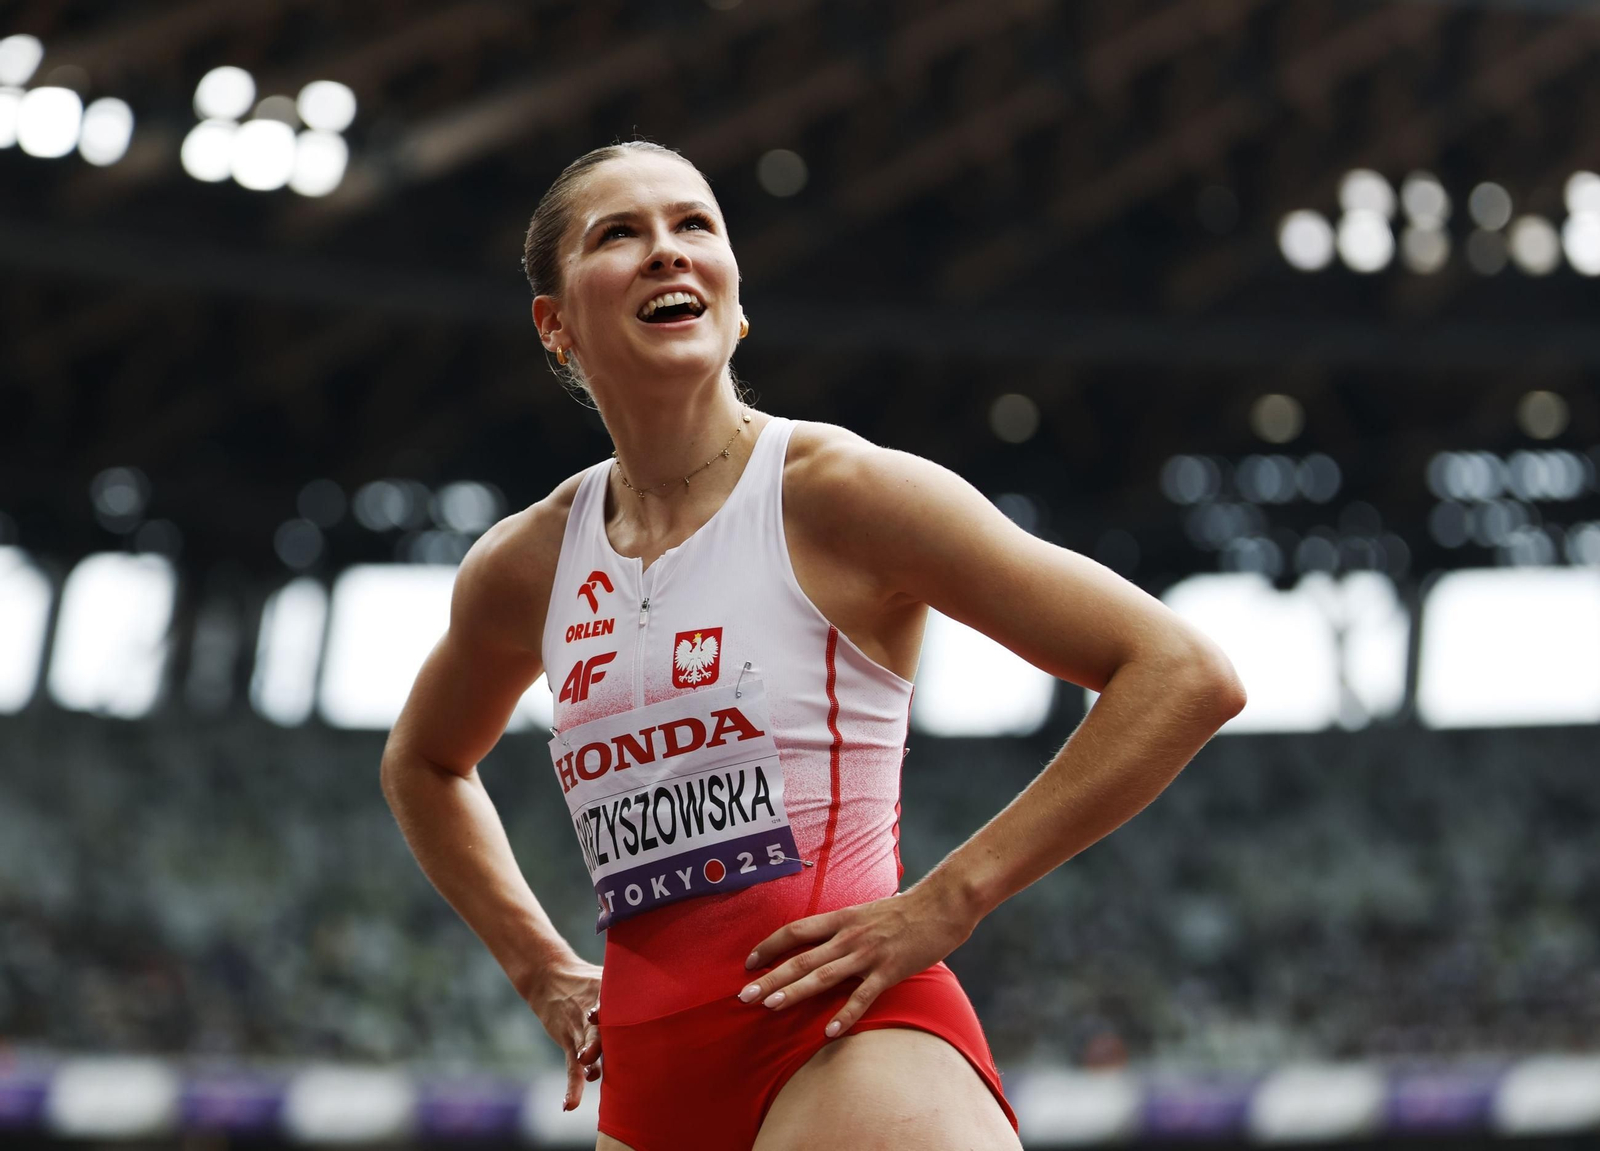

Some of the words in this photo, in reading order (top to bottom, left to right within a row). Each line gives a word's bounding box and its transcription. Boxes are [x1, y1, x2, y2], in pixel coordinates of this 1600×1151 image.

[565, 618, 615, 644] ORLEN
[559, 651, 618, 705] 4F
[555, 706, 766, 794] HONDA
[736, 842, 786, 875] 25
